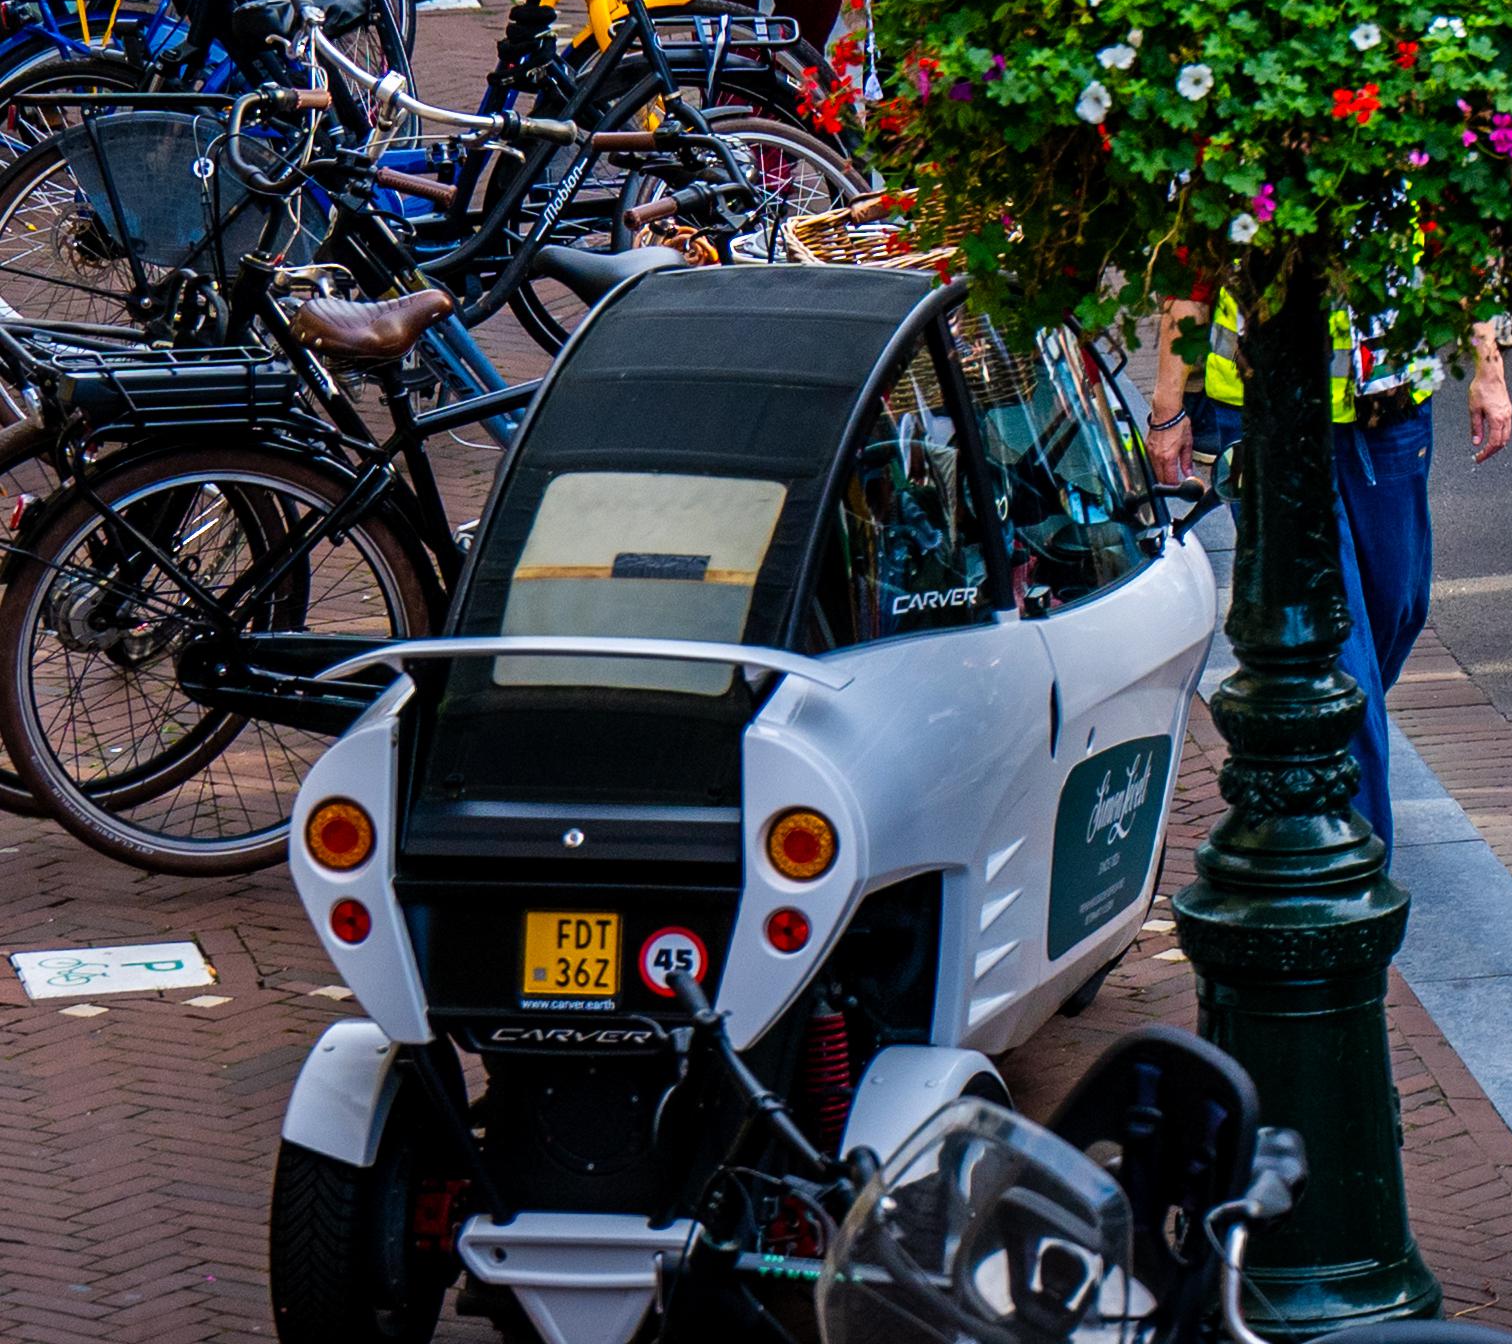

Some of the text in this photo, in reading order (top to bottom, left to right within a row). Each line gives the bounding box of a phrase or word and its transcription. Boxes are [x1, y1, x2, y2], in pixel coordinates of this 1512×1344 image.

[892, 587, 978, 615] CARVER
[557, 919, 612, 949] FDT
[555, 958, 610, 988] 36Z
[654, 949, 693, 972] 45
[522, 999, 616, 1011] www.carver.earth
[492, 1027, 653, 1044] CARVER
